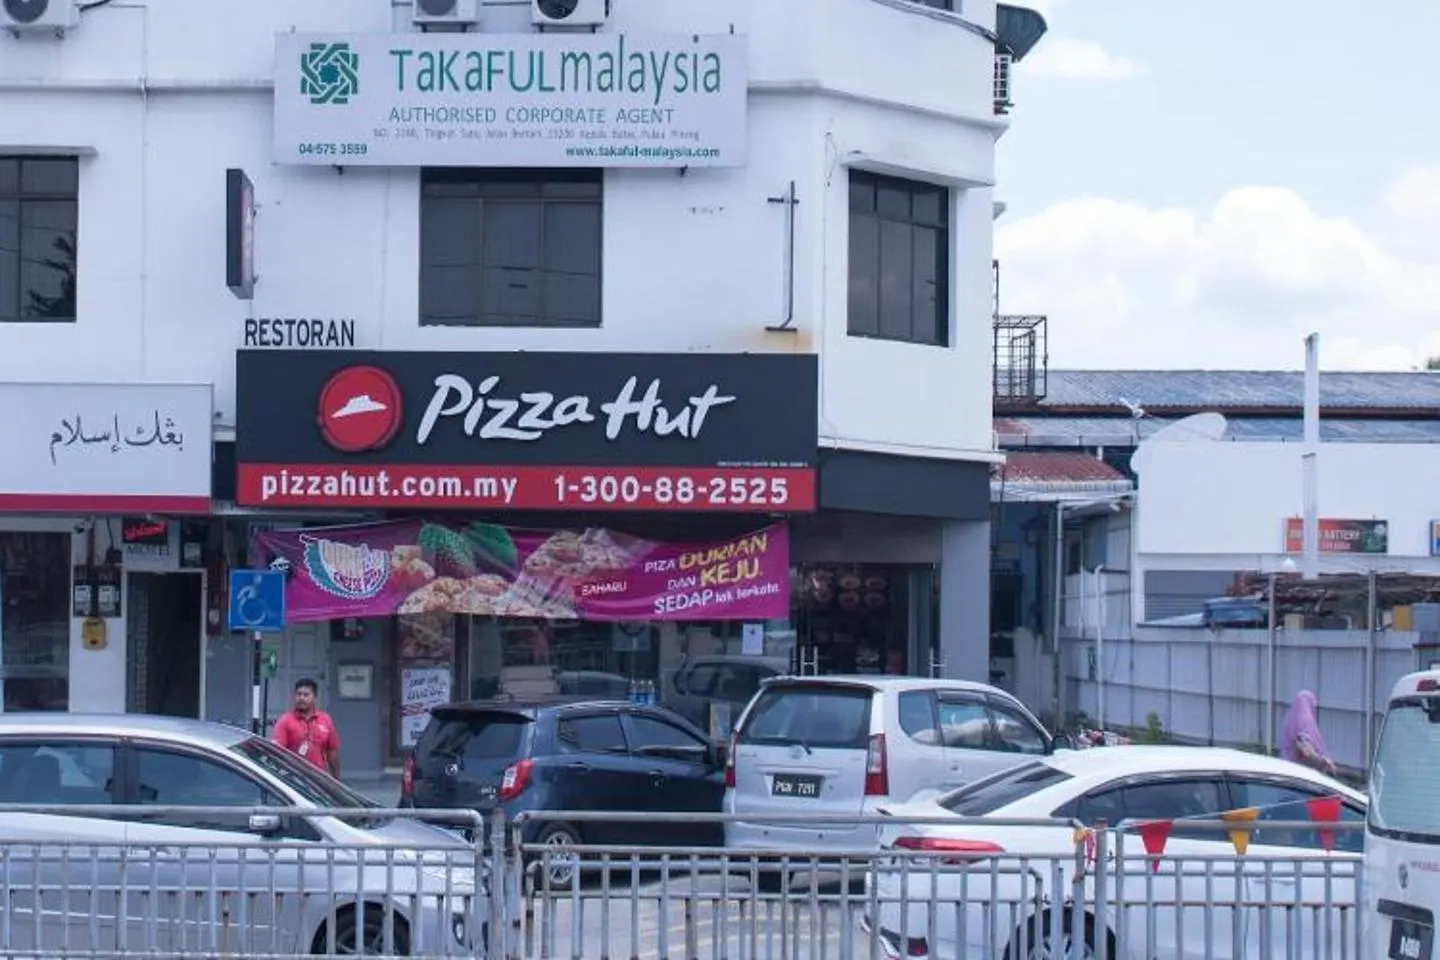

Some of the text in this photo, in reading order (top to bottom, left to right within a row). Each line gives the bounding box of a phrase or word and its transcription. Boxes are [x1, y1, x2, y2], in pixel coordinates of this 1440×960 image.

[389, 107, 674, 124] AUTHORISED CORPORATE AGENT
[245, 319, 355, 347] RESTORAN
[416, 374, 736, 444] Pizza Hut
[262, 471, 788, 504] pizzahut.com.my 1-300-88-2525
[645, 532, 767, 572] PIZA DURIAN
[668, 557, 760, 590] DAN KEJU
[654, 589, 713, 614] SEDAP
